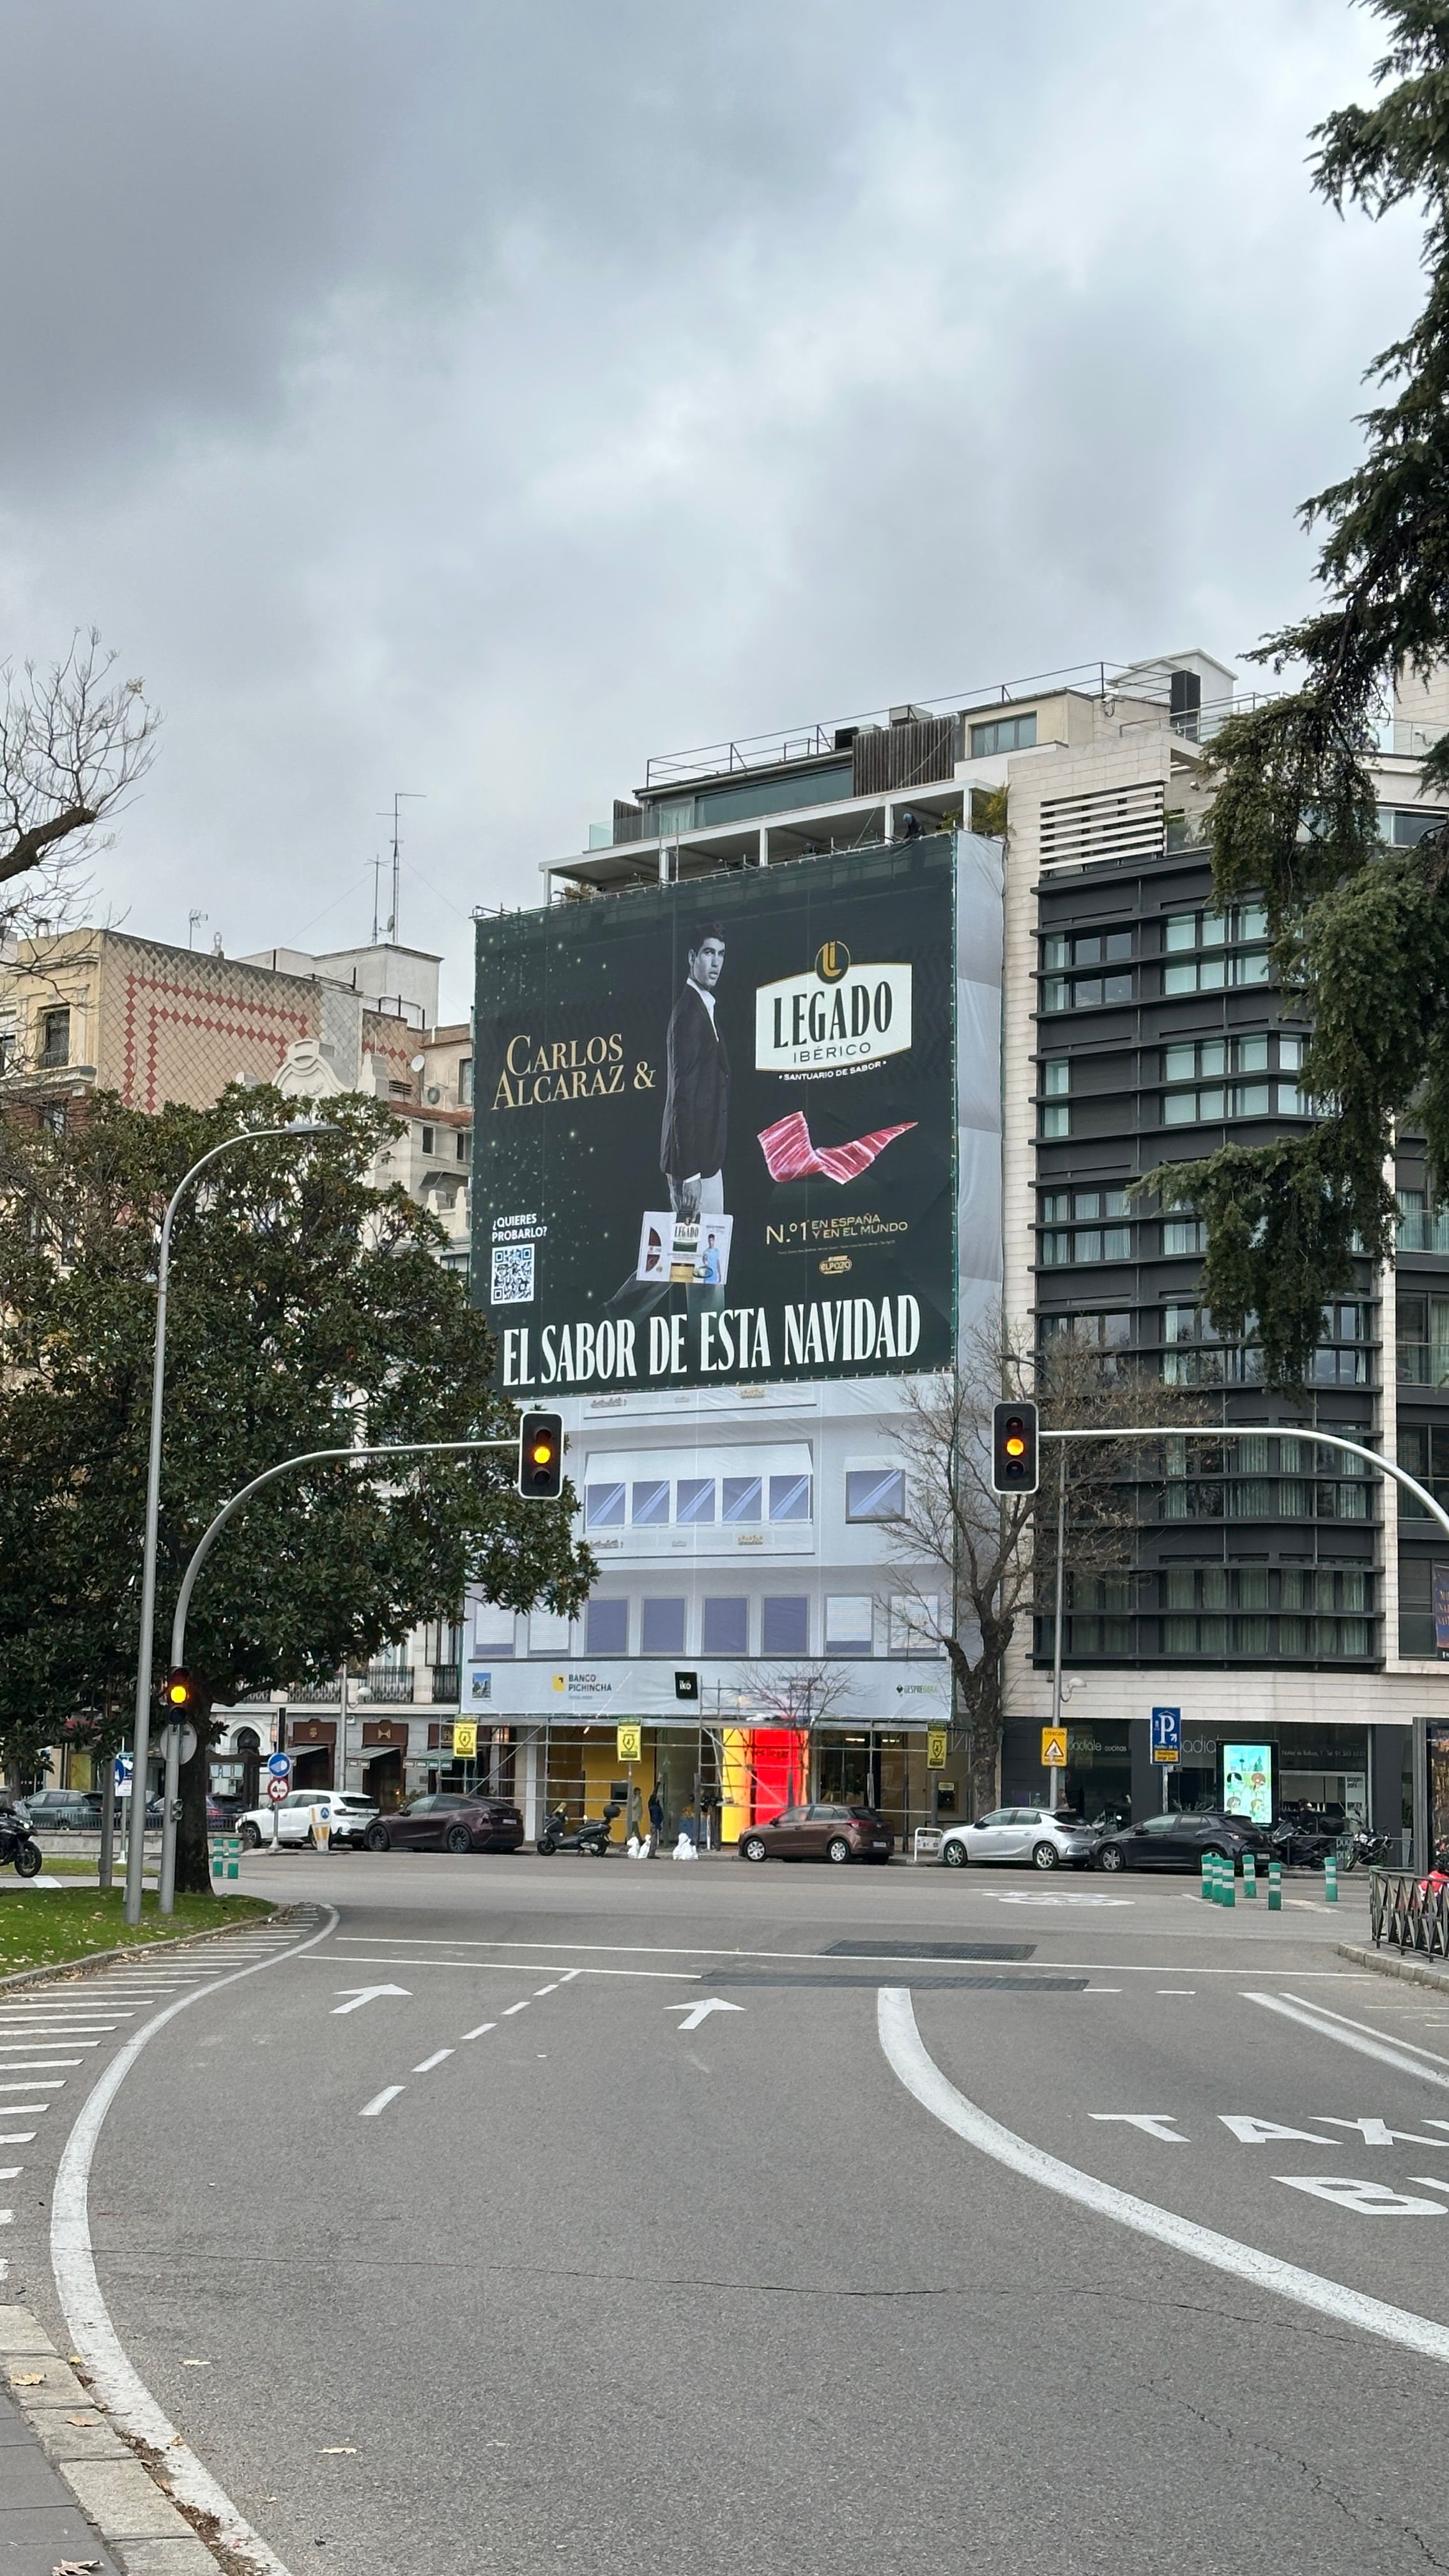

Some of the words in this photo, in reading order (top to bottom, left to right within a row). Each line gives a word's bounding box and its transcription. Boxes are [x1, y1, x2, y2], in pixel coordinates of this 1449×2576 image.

[774, 981, 893, 1048] LEGADO
[507, 1033, 624, 1076] CARLOS
[793, 1042, 871, 1063] IBÉRICO
[783, 1071, 834, 1081] SANTUARIO
[836, 1068, 848, 1077] DE
[850, 1061, 882, 1075] SABOR
[490, 1064, 625, 1110] ALCARAZ
[633, 1061, 657, 1089] &
[492, 1213, 537, 1230] ¿QUIERES
[812, 1220, 829, 1230] EN
[831, 1213, 881, 1228] ESPAÑA
[812, 1230, 820, 1240] Y
[823, 1229, 840, 1239] EN
[843, 1227, 858, 1237] EL
[860, 1221, 908, 1235] MUNDO
[492, 1226, 548, 1243] PROBARLO?
[503, 1328, 535, 1386] EL
[540, 1319, 638, 1384] SABOR
[649, 1314, 688, 1376] DE
[700, 1307, 771, 1372] ESTA
[784, 1294, 921, 1365] NAVIDAD
[568, 1674, 596, 1682] BANCO
[568, 1683, 612, 1692] PICHINCHA
[1158, 1714, 1175, 1744] P
